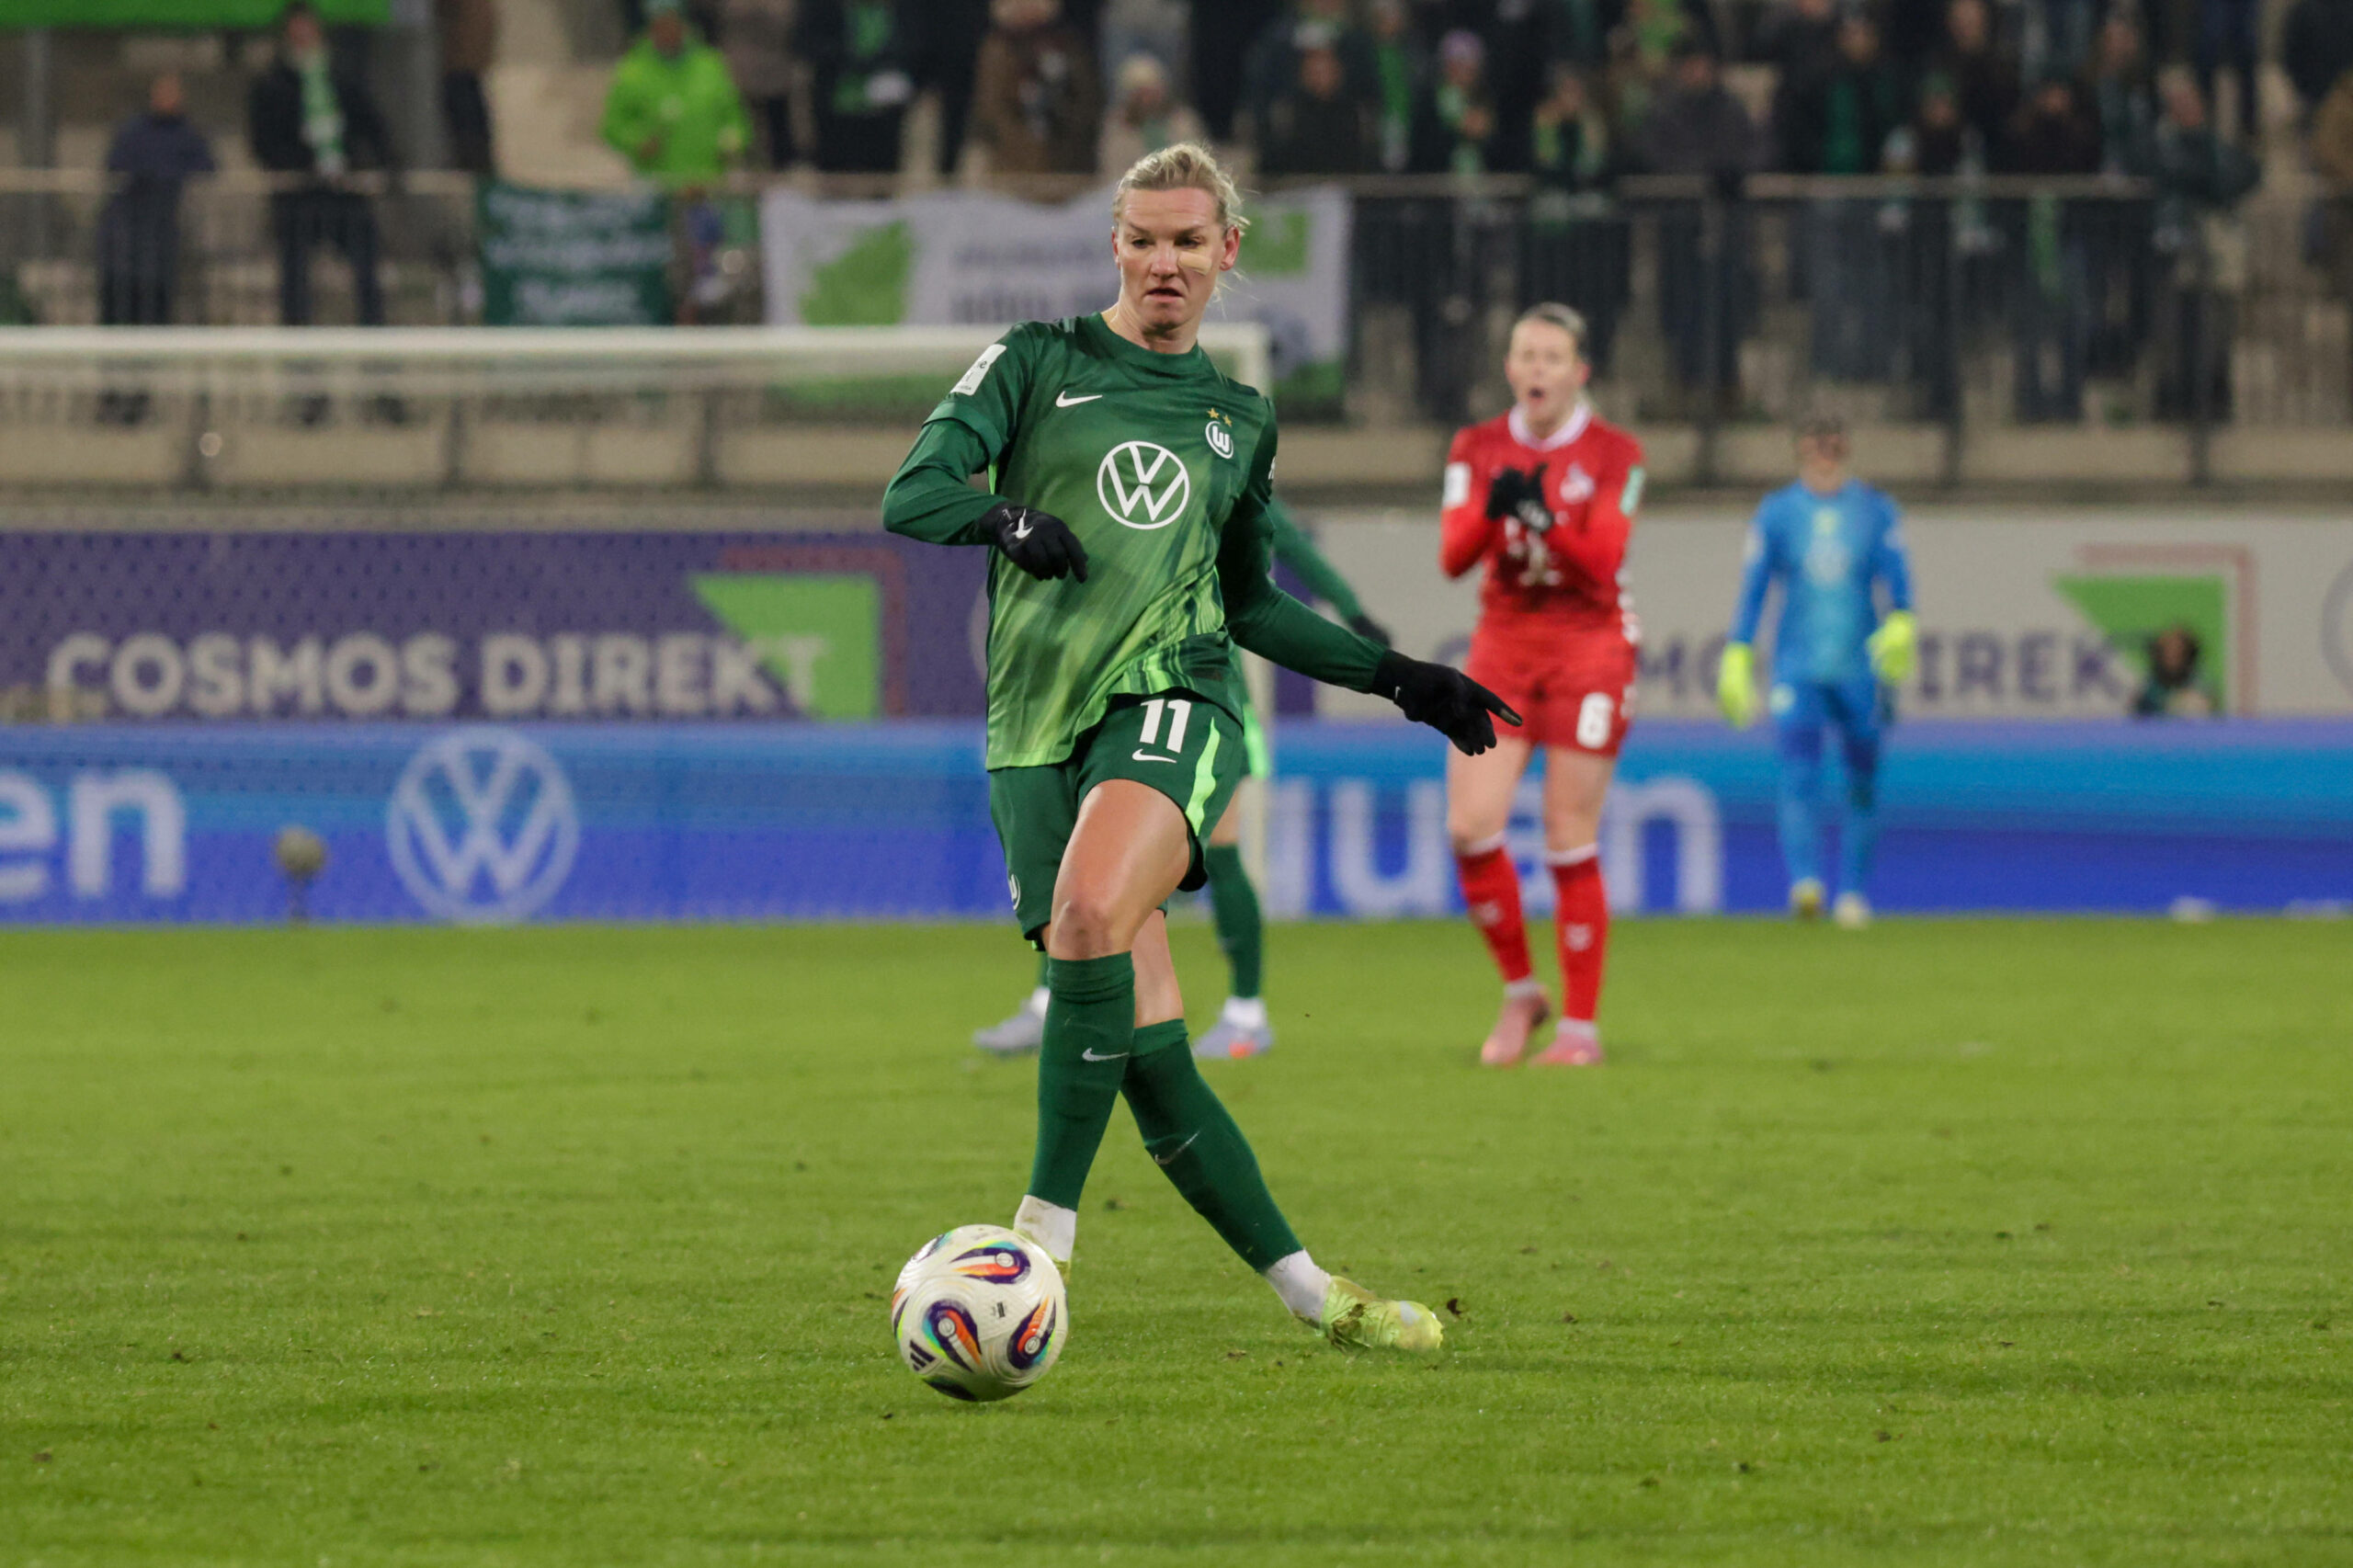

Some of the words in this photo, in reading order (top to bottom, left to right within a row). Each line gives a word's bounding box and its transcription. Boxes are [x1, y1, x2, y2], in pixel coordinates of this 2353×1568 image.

[1098, 442, 1189, 529] VW
[47, 631, 459, 714] COSMOS
[481, 631, 829, 713] DIREKT
[1140, 699, 1192, 754] 11
[386, 726, 581, 925] VW
